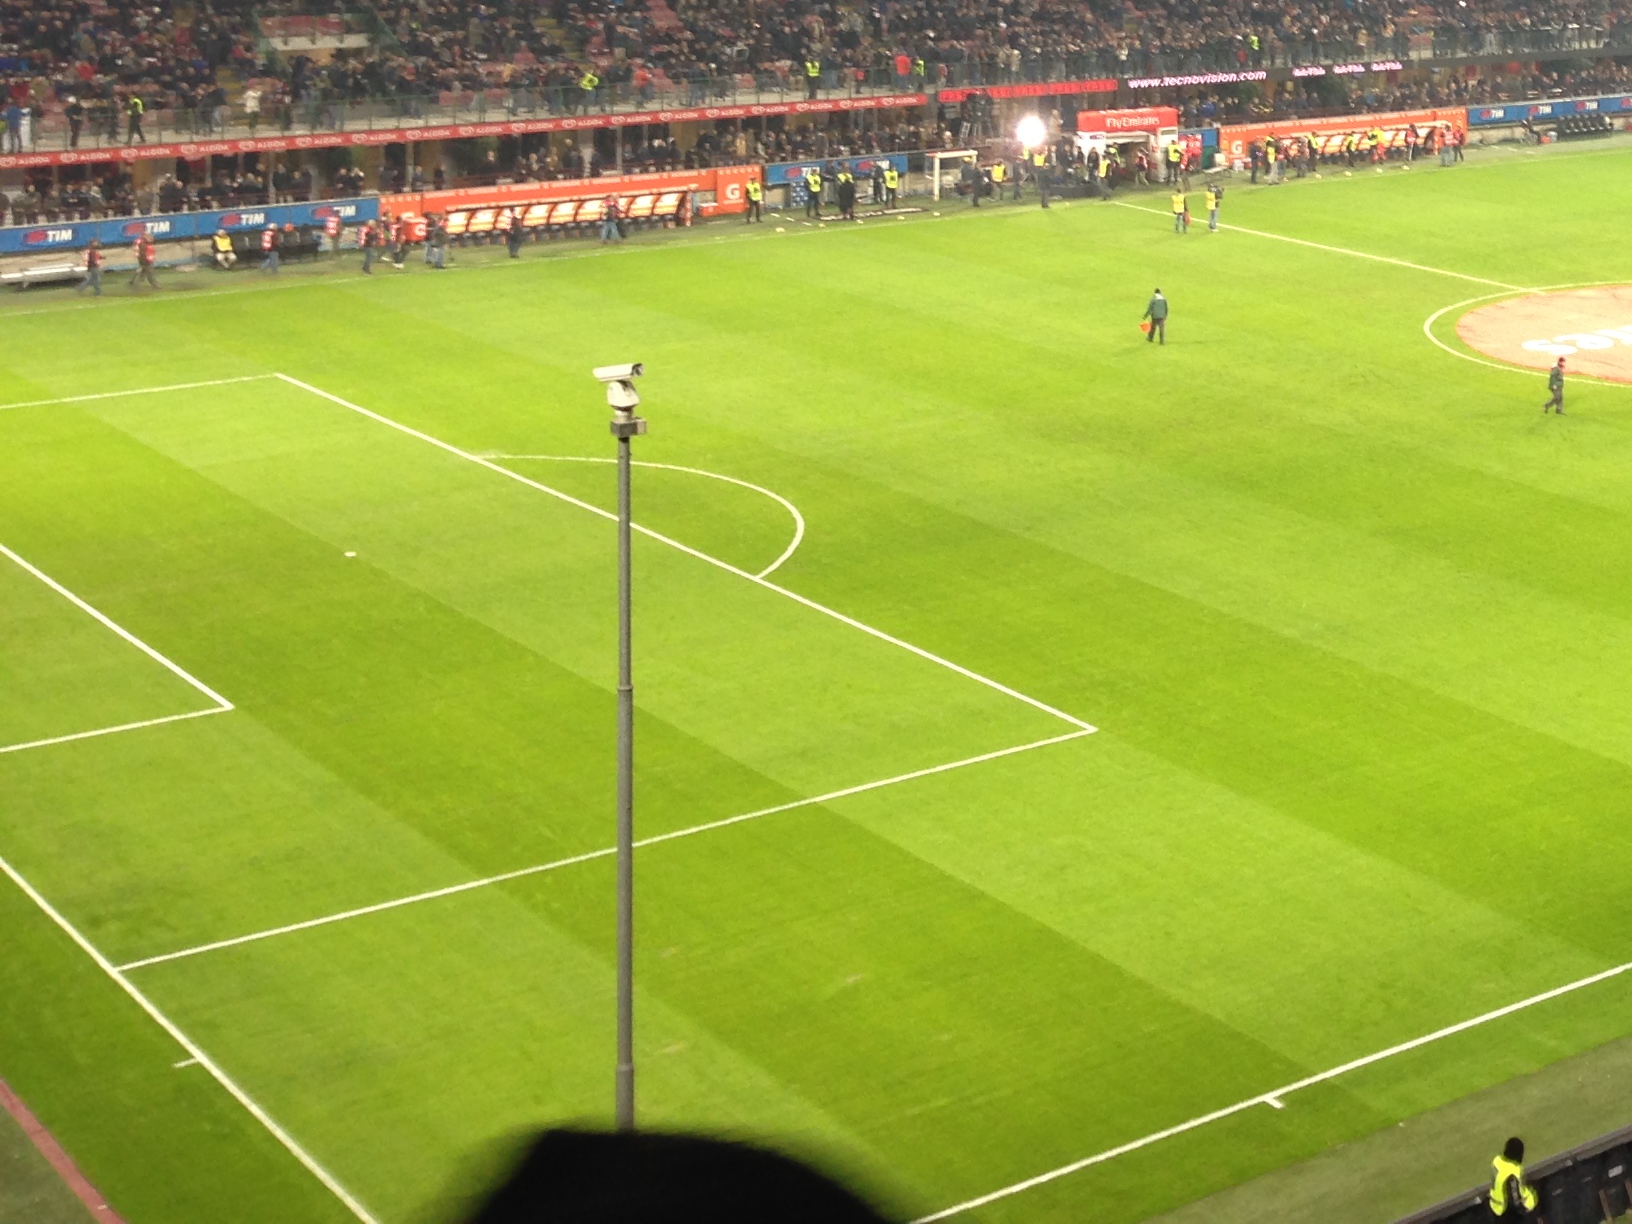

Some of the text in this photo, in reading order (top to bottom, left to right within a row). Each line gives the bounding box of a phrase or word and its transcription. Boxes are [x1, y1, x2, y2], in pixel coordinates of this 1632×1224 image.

[46, 229, 73, 242] TIM
[145, 221, 171, 234] TIM
[241, 213, 265, 226] TIM
